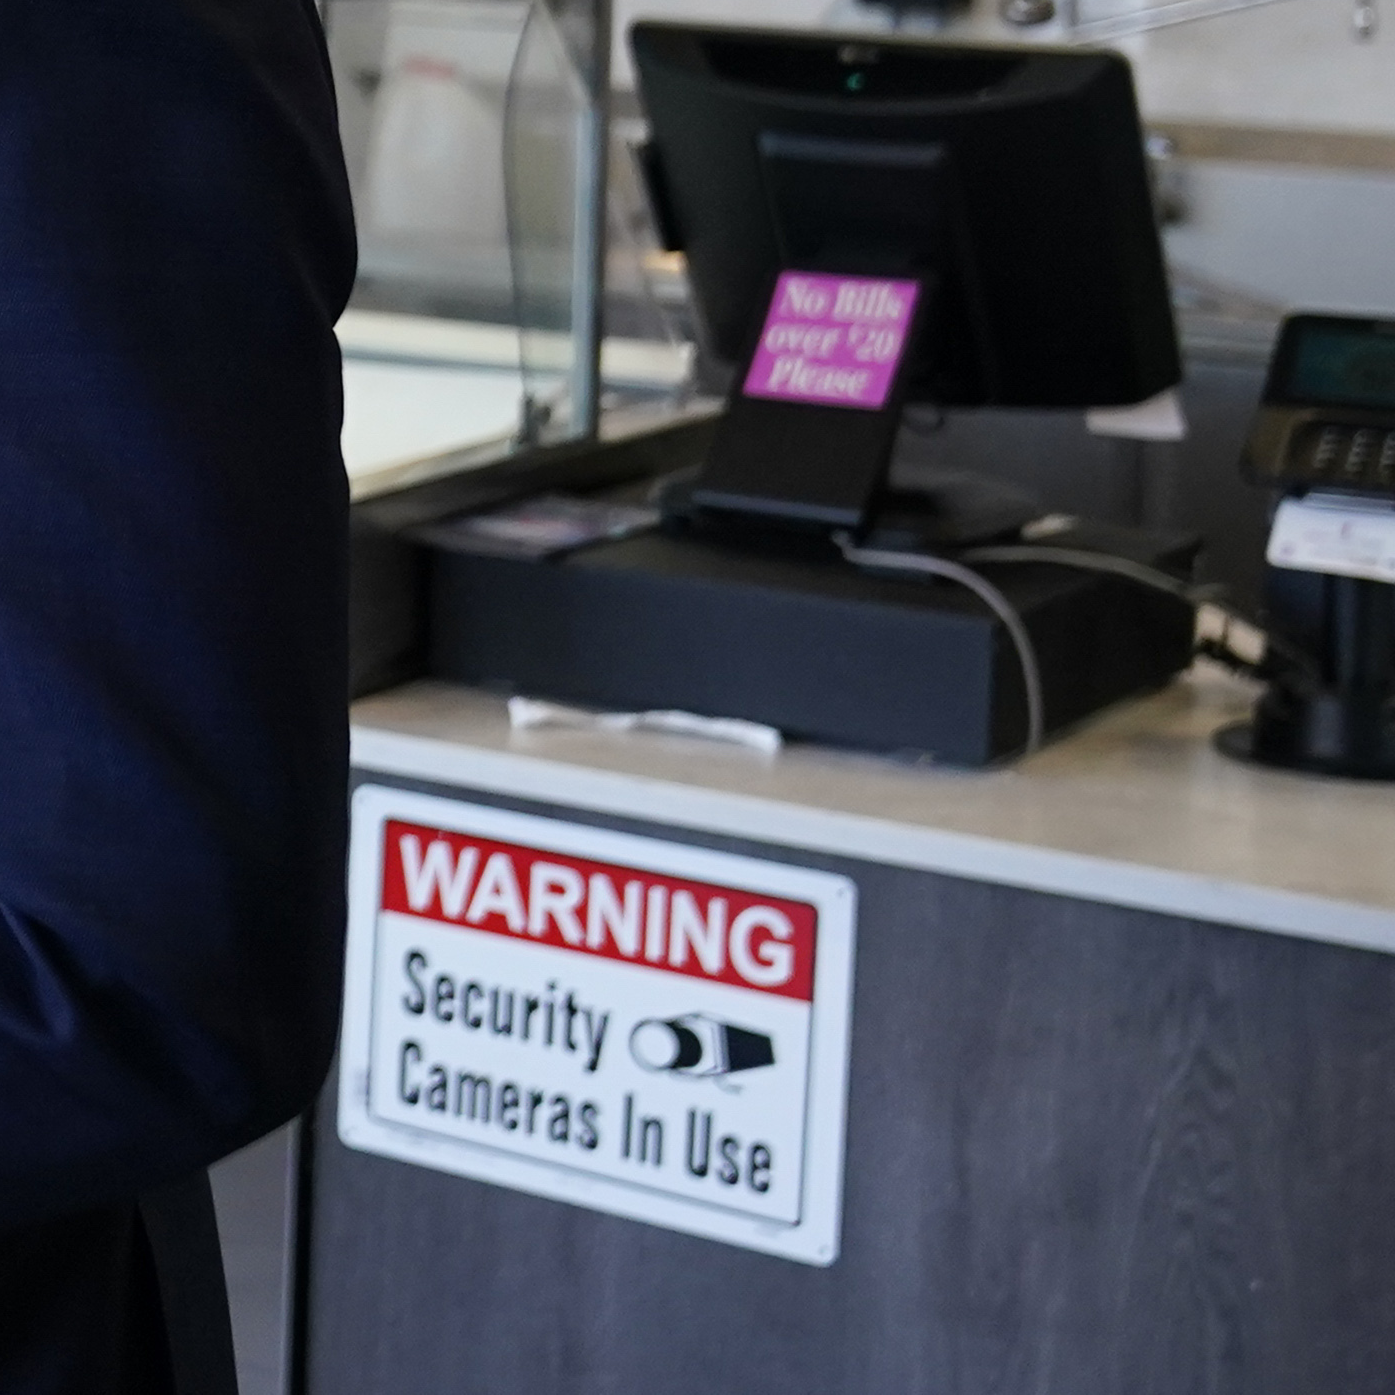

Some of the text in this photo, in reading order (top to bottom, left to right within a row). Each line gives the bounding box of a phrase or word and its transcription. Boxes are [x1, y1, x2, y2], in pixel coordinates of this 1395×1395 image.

[765, 326, 841, 358] over
[781, 277, 904, 322] No Bills
[767, 356, 869, 399] Please
[398, 834, 795, 987] WARNING
[402, 947, 610, 1073] Security
[398, 1037, 772, 1194] Cameras In Use
